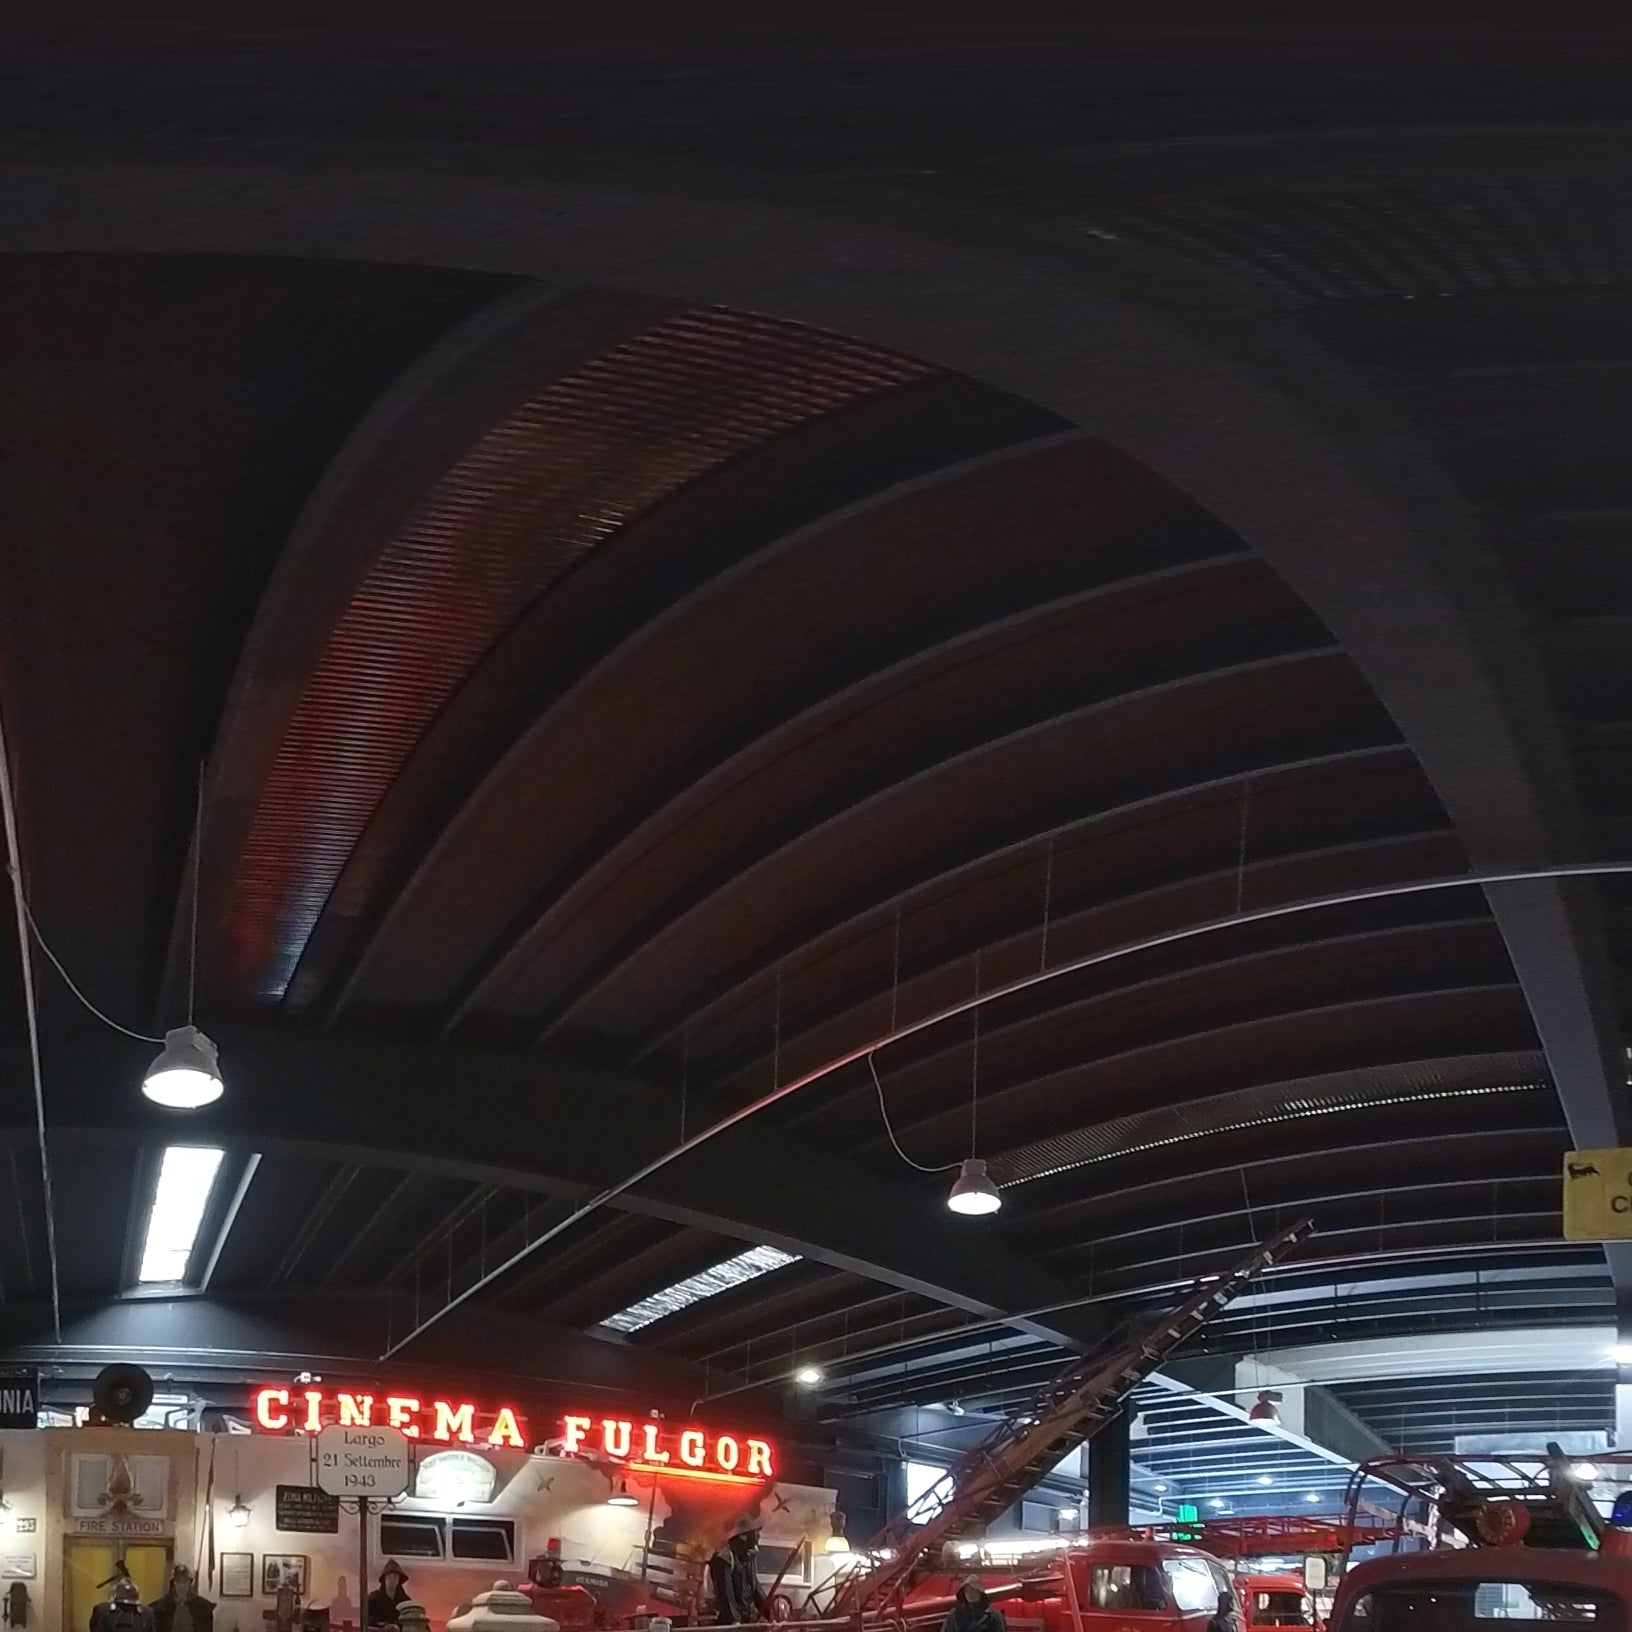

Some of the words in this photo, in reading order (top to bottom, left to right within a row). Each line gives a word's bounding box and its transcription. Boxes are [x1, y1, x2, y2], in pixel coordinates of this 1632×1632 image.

[257, 1389, 524, 1447] CINEMA
[564, 1415, 773, 1476] FULGOR
[344, 1431, 385, 1448] Largo
[323, 1453, 338, 1467] 21
[344, 1453, 401, 1468] Settembre
[344, 1474, 376, 1488] 1943
[80, 1521, 106, 1532] FIRE
[111, 1521, 160, 1532] STATION
